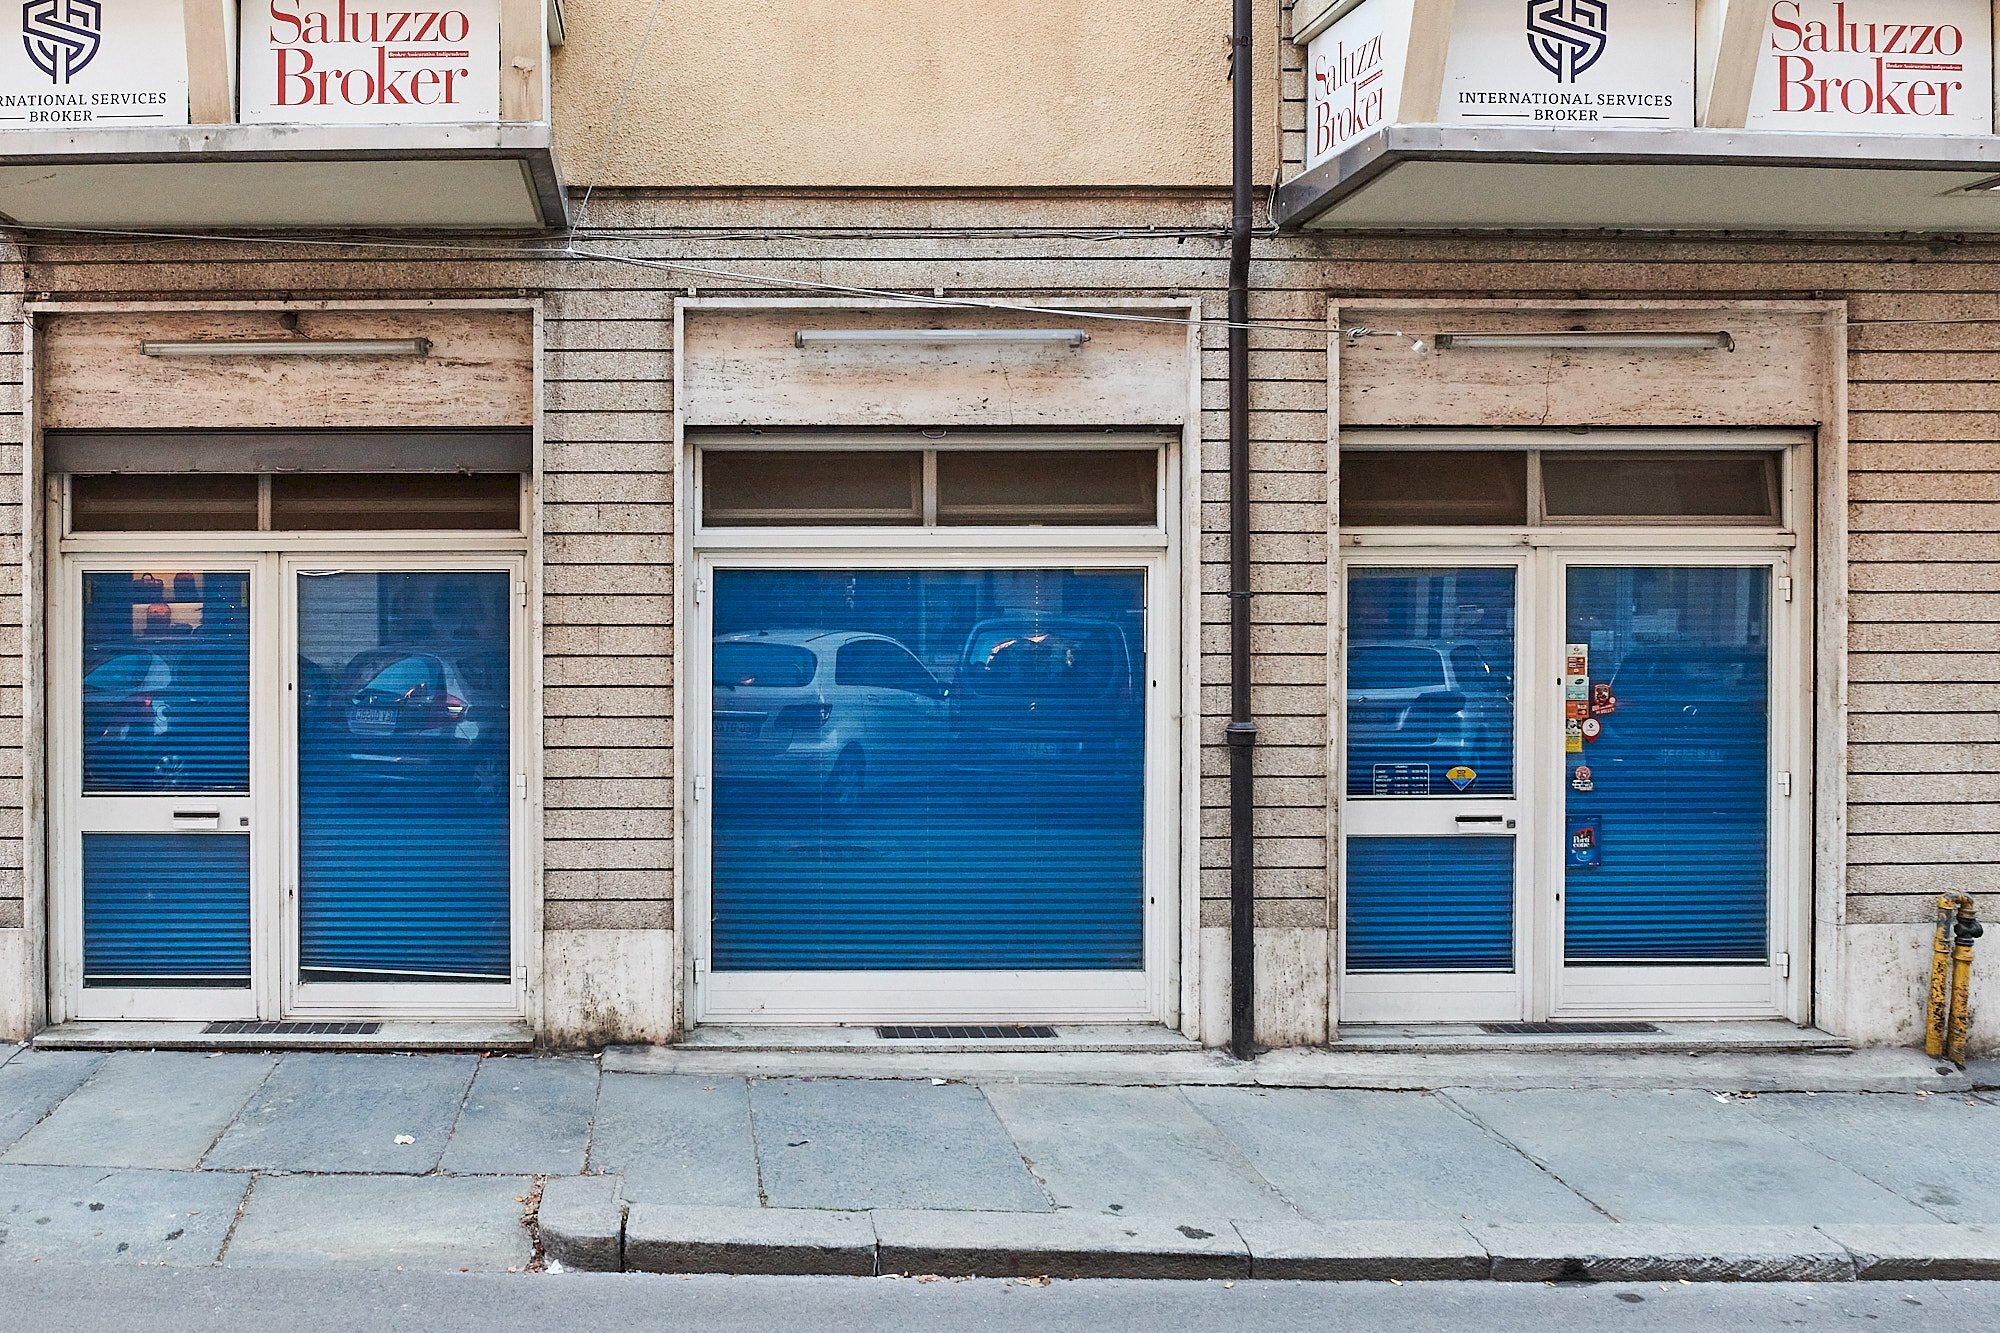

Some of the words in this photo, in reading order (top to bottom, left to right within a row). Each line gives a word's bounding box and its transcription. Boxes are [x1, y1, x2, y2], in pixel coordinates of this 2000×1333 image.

[269, 0, 470, 44] Saluzzo
[1771, 0, 1963, 56] Saluzzo
[269, 45, 470, 106] Broker
[1771, 55, 1963, 116] Broker
[91, 92, 167, 105] SERVICES
[1458, 92, 1593, 105] INTERNATIONAL
[1597, 93, 1673, 107] SERVICES
[29, 110, 93, 123] BROKER
[1534, 109, 1598, 121] BROKER
